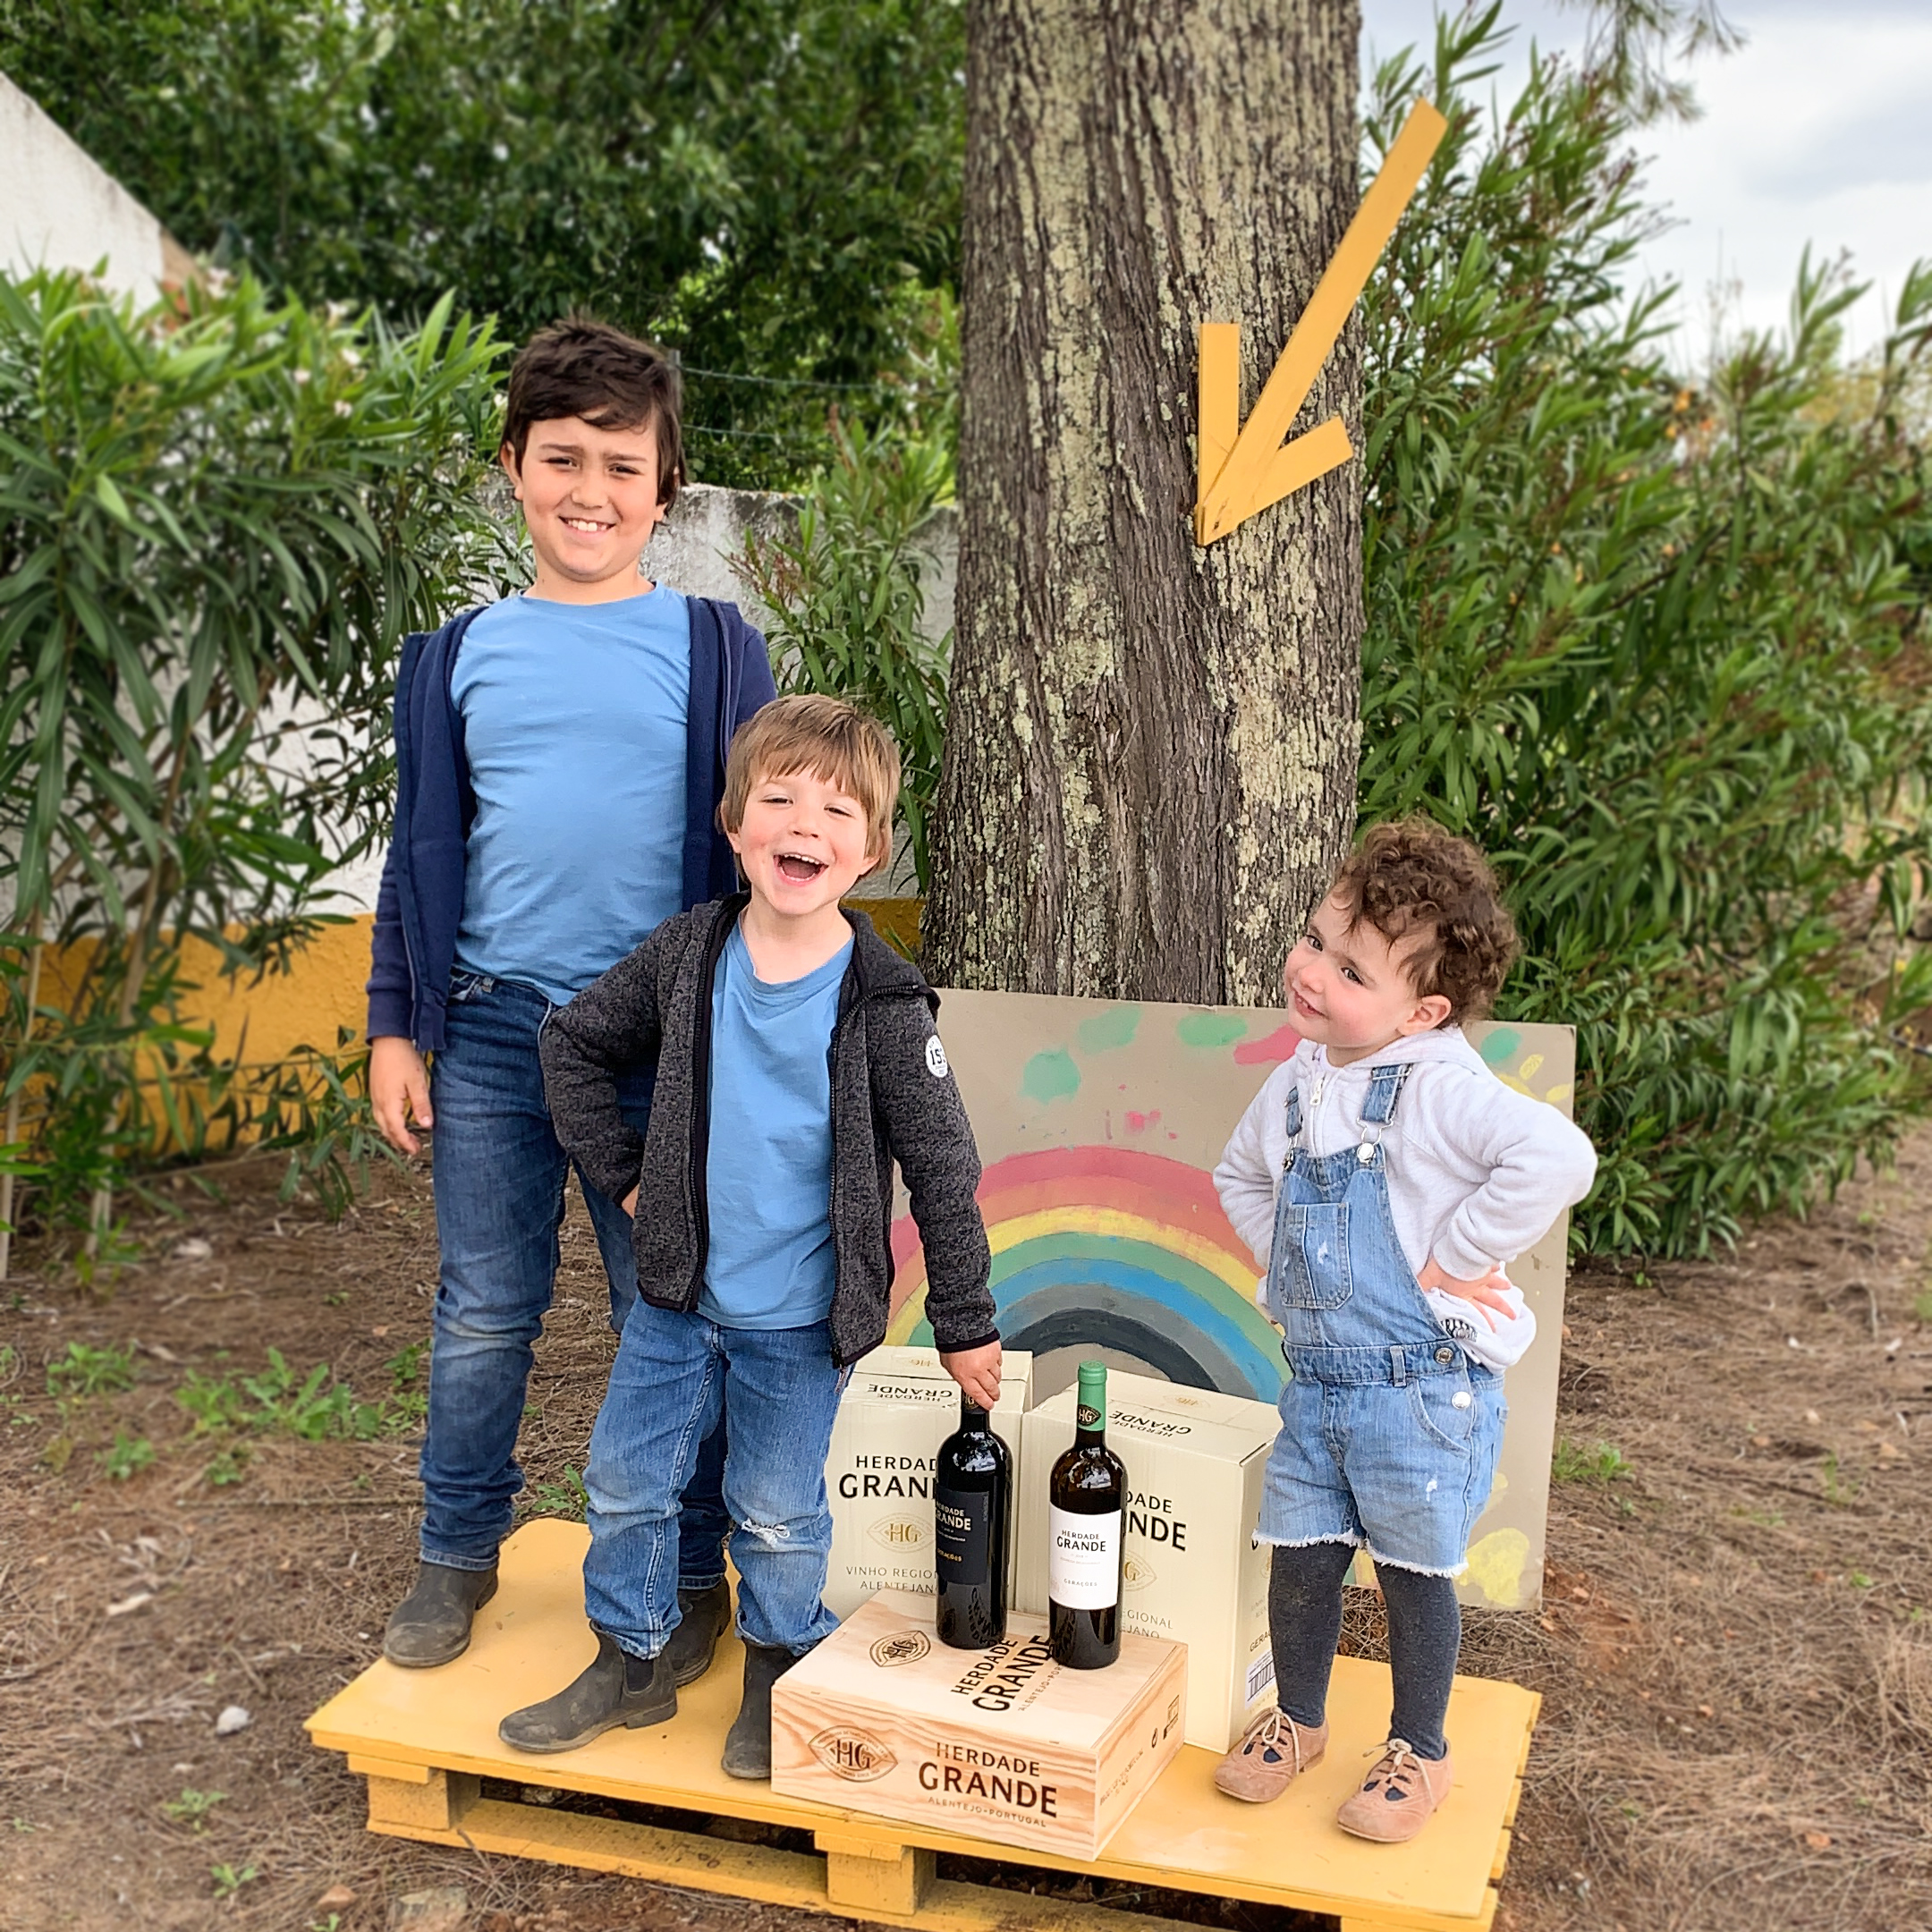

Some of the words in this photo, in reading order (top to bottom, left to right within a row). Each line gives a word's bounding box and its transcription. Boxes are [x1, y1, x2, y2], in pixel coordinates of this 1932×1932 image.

[930, 1047, 946, 1065] 15
[868, 1384, 953, 1398] GRANDE
[877, 1393, 940, 1402] HERDADE
[1078, 1408, 1093, 1422] HG
[1108, 1410, 1192, 1435] GRANDE
[1112, 1419, 1174, 1437] HERDADE
[856, 1455, 936, 1471] HERDAD
[839, 1473, 936, 1500] GRAN
[1125, 1490, 1173, 1514] DADE
[936, 1509, 971, 1531] RANDE
[889, 1523, 918, 1543] HG
[1061, 1530, 1100, 1540] HERDADE
[1128, 1510, 1187, 1552] NDE
[1056, 1535, 1106, 1552] GRANDE
[846, 1566, 887, 1577] VINHO
[893, 1568, 936, 1580] REGIO
[1124, 1562, 1137, 1581] G
[1122, 1608, 1173, 1630] EGIONAL
[1121, 1623, 1160, 1639] EJANO
[950, 1639, 1018, 1696] HERDADE
[971, 1635, 1051, 1712] GRANDE
[836, 1739, 870, 1769] HG
[936, 1741, 1040, 1777] HERDADE
[919, 1761, 1057, 1819] GRANDE
